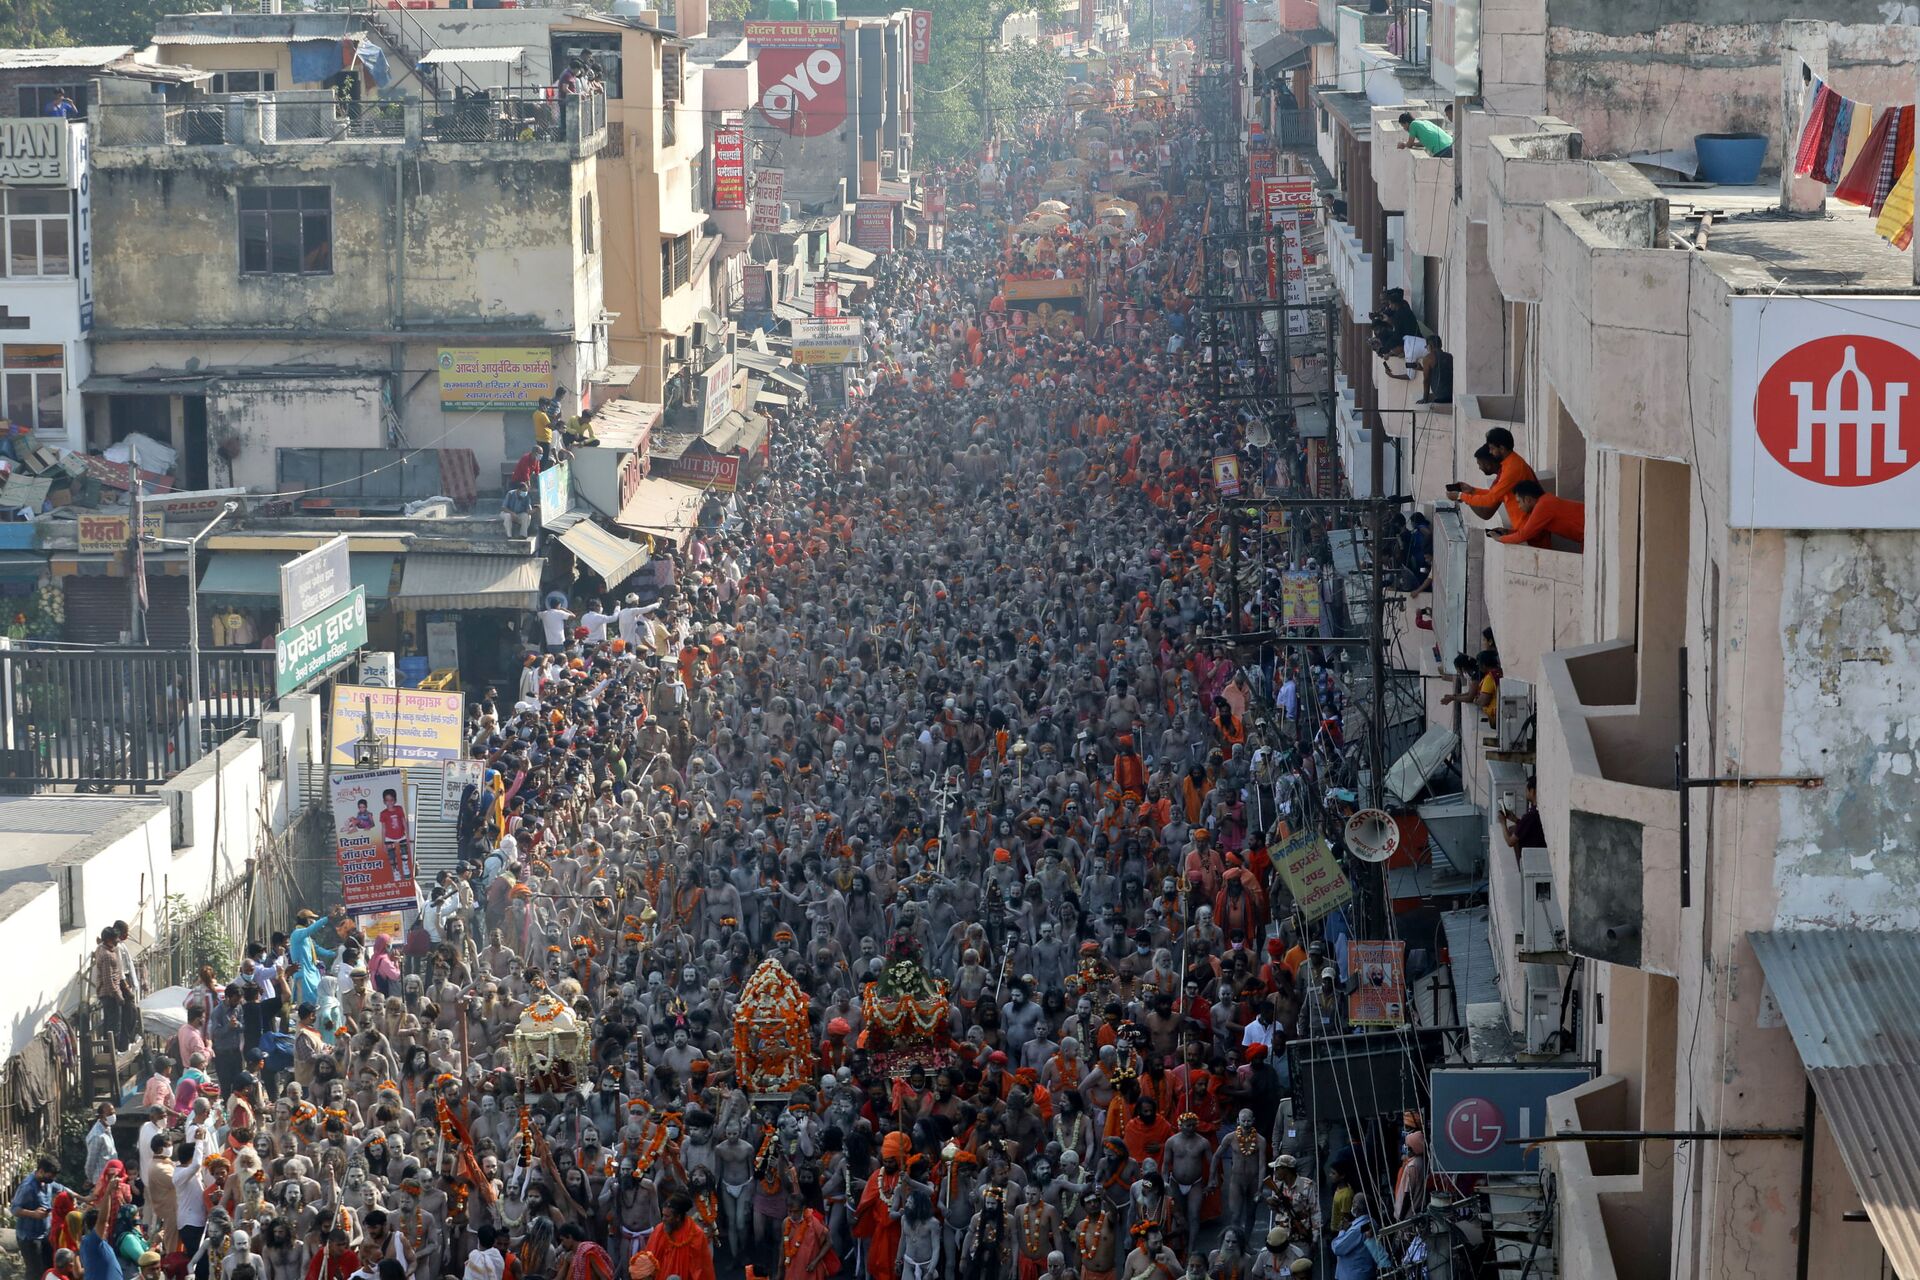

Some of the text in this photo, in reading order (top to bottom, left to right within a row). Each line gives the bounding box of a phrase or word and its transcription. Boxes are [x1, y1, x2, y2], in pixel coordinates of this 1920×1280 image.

[747, 24, 776, 35] होटल
[808, 26, 837, 37] कृष्णा
[914, 17, 927, 51] OYO
[763, 50, 841, 119] OYO
[79, 137, 90, 300] HOTEL
[456, 360, 479, 373] आदर्श
[481, 360, 520, 377] आयुर्वेदिक
[703, 460, 735, 479] BHOJ
[168, 501, 217, 511] RALCO
[287, 605, 354, 671] प्रवेश द्वार
[1449, 1098, 1540, 1153] LG L
